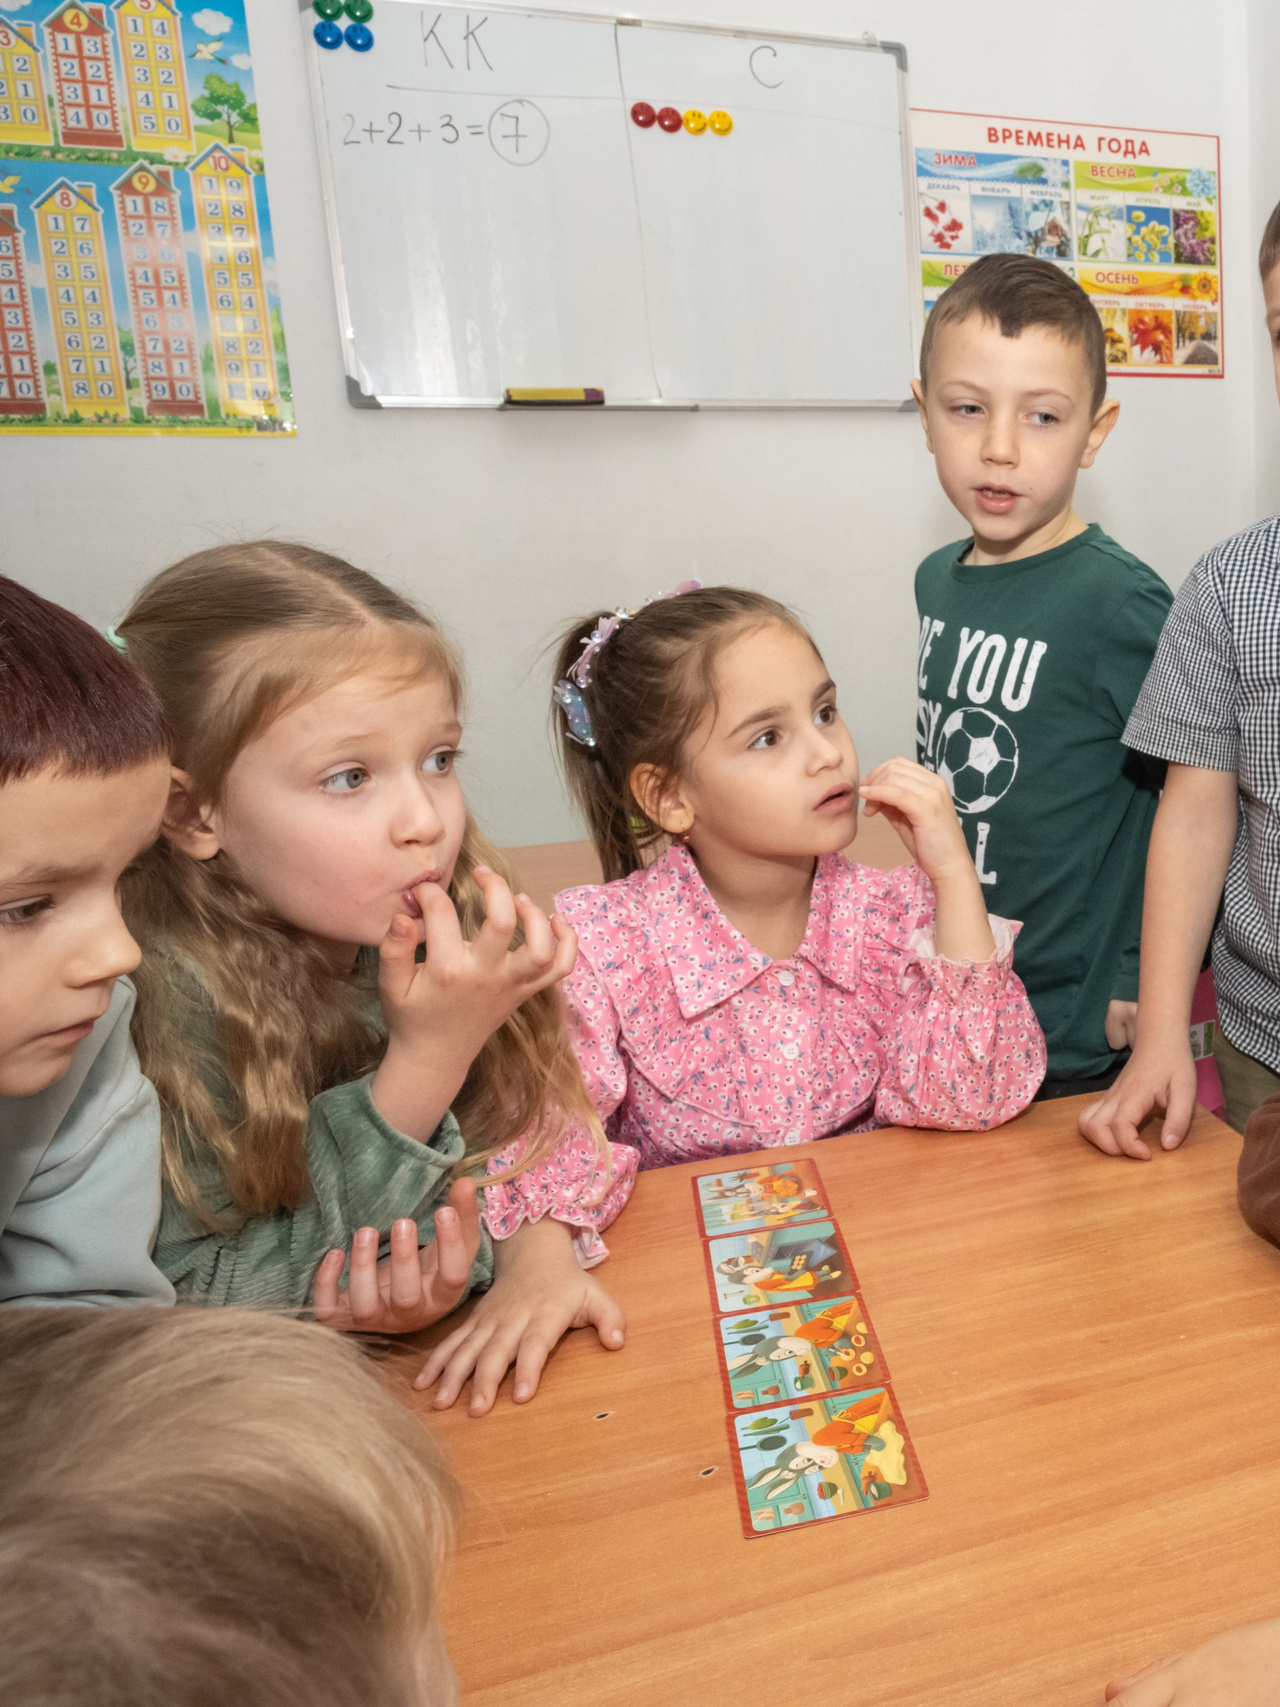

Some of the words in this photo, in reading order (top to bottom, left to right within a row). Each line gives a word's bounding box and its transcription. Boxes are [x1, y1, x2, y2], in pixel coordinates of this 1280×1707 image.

[70, 12, 82, 28] 4
[131, 19, 139, 33] 1
[155, 21, 168, 35] 4
[0, 30, 11, 46] 3
[62, 37, 70, 51] 1
[87, 39, 100, 53] 3
[133, 44, 146, 58] 2
[158, 47, 172, 61] 3
[16, 58, 29, 72] 2
[63, 62, 76, 76] 2
[89, 65, 102, 79] 2
[136, 68, 150, 82] 3
[161, 70, 174, 84] 2
[22, 82, 30, 96] 1
[67, 86, 80, 100] 3
[95, 88, 103, 102] 1
[139, 92, 152, 106] 4
[166, 95, 174, 109] 1
[22, 108, 36, 122] 0
[69, 110, 82, 124] 4
[96, 112, 108, 126] 0
[143, 116, 156, 130] 5
[166, 118, 180, 132] 0
[987, 127, 1086, 151] ВРЕМЕНА
[1098, 137, 1151, 159] ГОДА
[210, 155, 231, 172] 10
[934, 152, 978, 168] ЗИМА
[1091, 165, 1136, 179] ВЕСНА
[138, 175, 150, 191] 9
[207, 177, 215, 191] 1
[228, 178, 241, 192] 9
[927, 182, 961, 192] ДЕКАБРЬ
[981, 186, 1011, 194] ЯНВАРЬ
[1029, 189, 1063, 198] ФЕВРАЛЬ
[59, 191, 71, 208] 8
[131, 199, 139, 213] 1
[154, 200, 167, 214] 8
[1089, 194, 1110, 202] МАРТ
[1135, 196, 1162, 205] АПРЕЛЬ
[1186, 198, 1202, 207] МАЙ
[206, 202, 220, 216] 2
[231, 204, 244, 218] 8
[52, 216, 60, 230] 1
[75, 217, 88, 231] 7
[131, 222, 144, 236] 2
[156, 223, 169, 237] 7
[234, 225, 247, 239] 7
[0, 239, 12, 253] 6
[54, 241, 66, 255] 2
[79, 242, 92, 256] 6
[237, 250, 250, 264] 6
[1, 262, 14, 276] 5
[56, 264, 69, 278] 3
[83, 265, 96, 279] 5
[943, 263, 969, 277] ЛЕТ
[139, 270, 152, 284] 4
[163, 270, 176, 284] 5
[216, 271, 230, 285] 5
[240, 272, 253, 286] 5
[1095, 271, 1139, 285] ОСЕНЬ
[3, 287, 16, 301] 4
[59, 289, 72, 303] 4
[86, 290, 99, 304] 4
[142, 291, 155, 305] 5
[166, 293, 179, 307] 4
[218, 294, 232, 308] 6
[242, 296, 255, 310] 4
[1091, 300, 1121, 308] ЕНТЯБРЬ
[1135, 301, 1166, 309] ОКТЯБРЬ
[1182, 303, 1208, 311] НОЯБРЬ
[7, 310, 20, 324] 3
[64, 311, 78, 325] 5
[89, 312, 102, 326] 3
[144, 314, 158, 328] 6
[249, 317, 258, 330] 3
[11, 335, 24, 349] 2
[66, 336, 80, 350] 6
[92, 336, 106, 350] 2
[147, 337, 160, 351] 7
[172, 339, 186, 353] 2
[225, 340, 238, 354] 8
[249, 340, 262, 354] 2
[18, 358, 26, 372] 1
[71, 358, 84, 372] 7
[98, 360, 106, 374] 1
[150, 360, 164, 374] 8
[178, 360, 186, 374] 1
[227, 360, 240, 374] 9
[254, 362, 262, 376] 1
[18, 382, 31, 396] 0
[76, 382, 88, 396] 8
[100, 382, 112, 396] 0
[154, 382, 166, 396] 9
[178, 384, 191, 398] 0
[947, 626, 1048, 712] YOU
